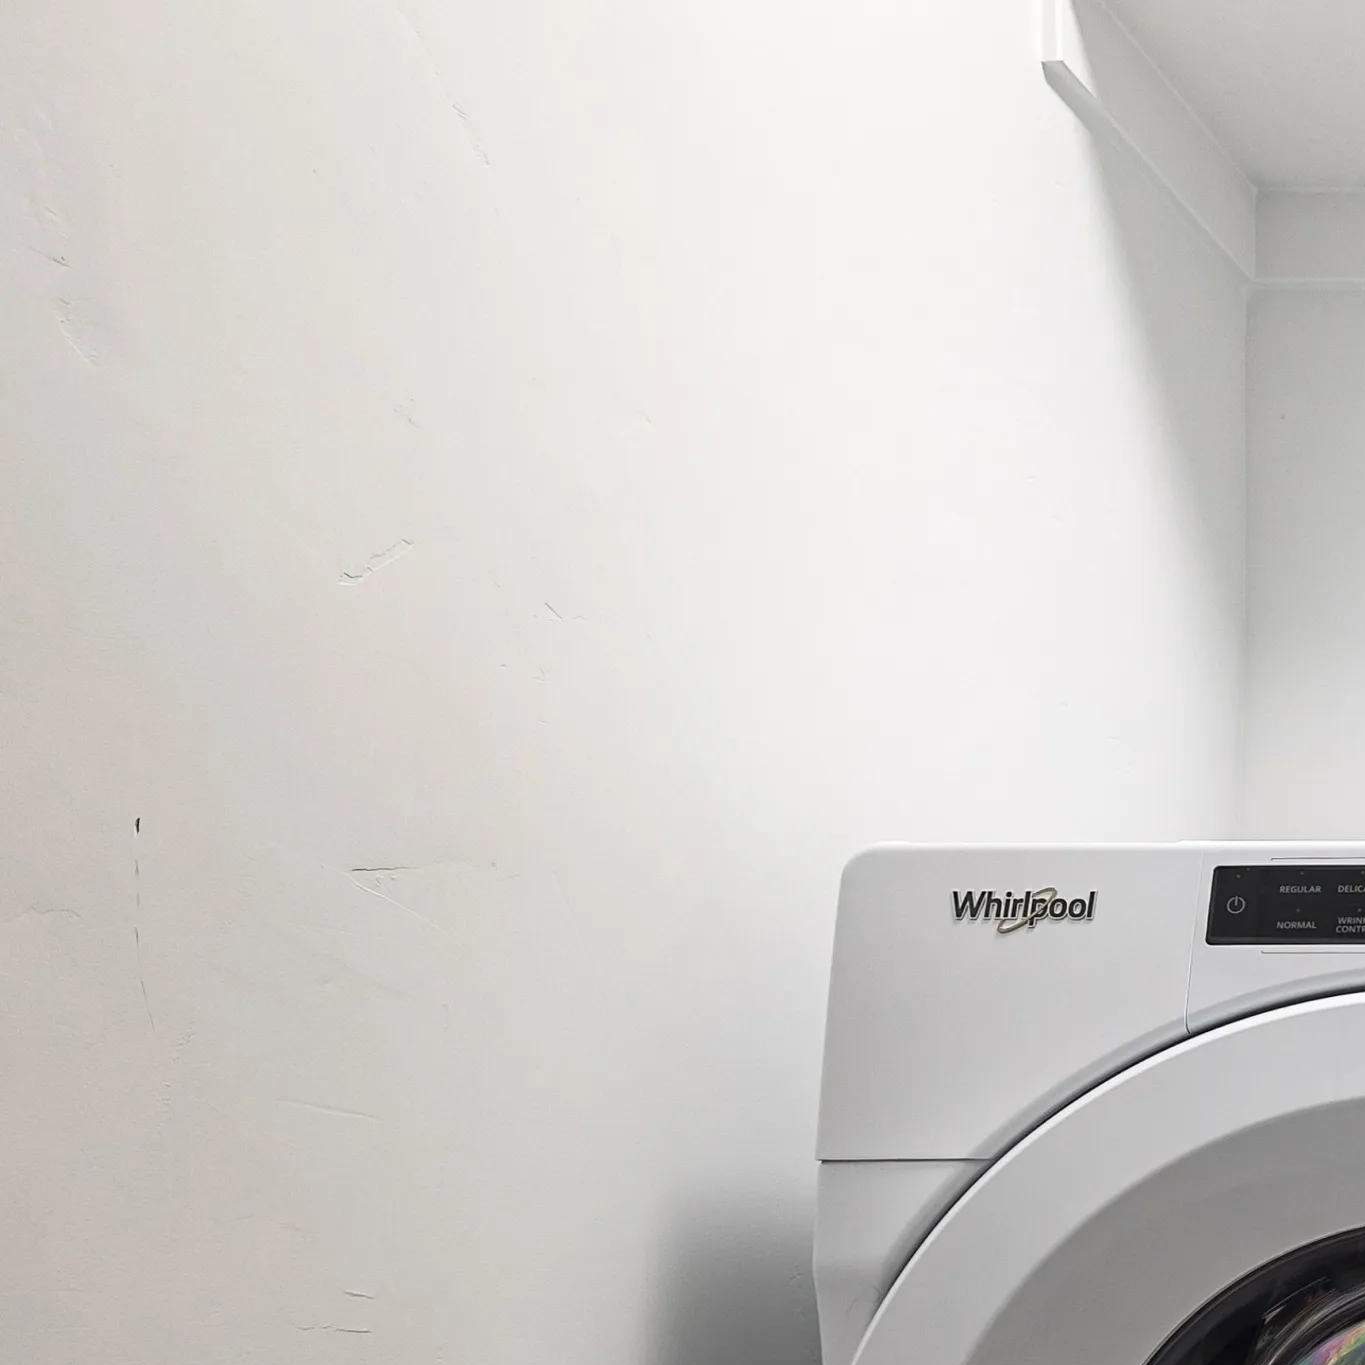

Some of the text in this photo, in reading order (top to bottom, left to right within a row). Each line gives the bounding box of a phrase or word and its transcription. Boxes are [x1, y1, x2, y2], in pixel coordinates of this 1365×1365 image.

[1279, 885, 1322, 894] REGULAR
[951, 888, 1097, 931] Whirlpool
[1276, 920, 1317, 929] NORMAL
